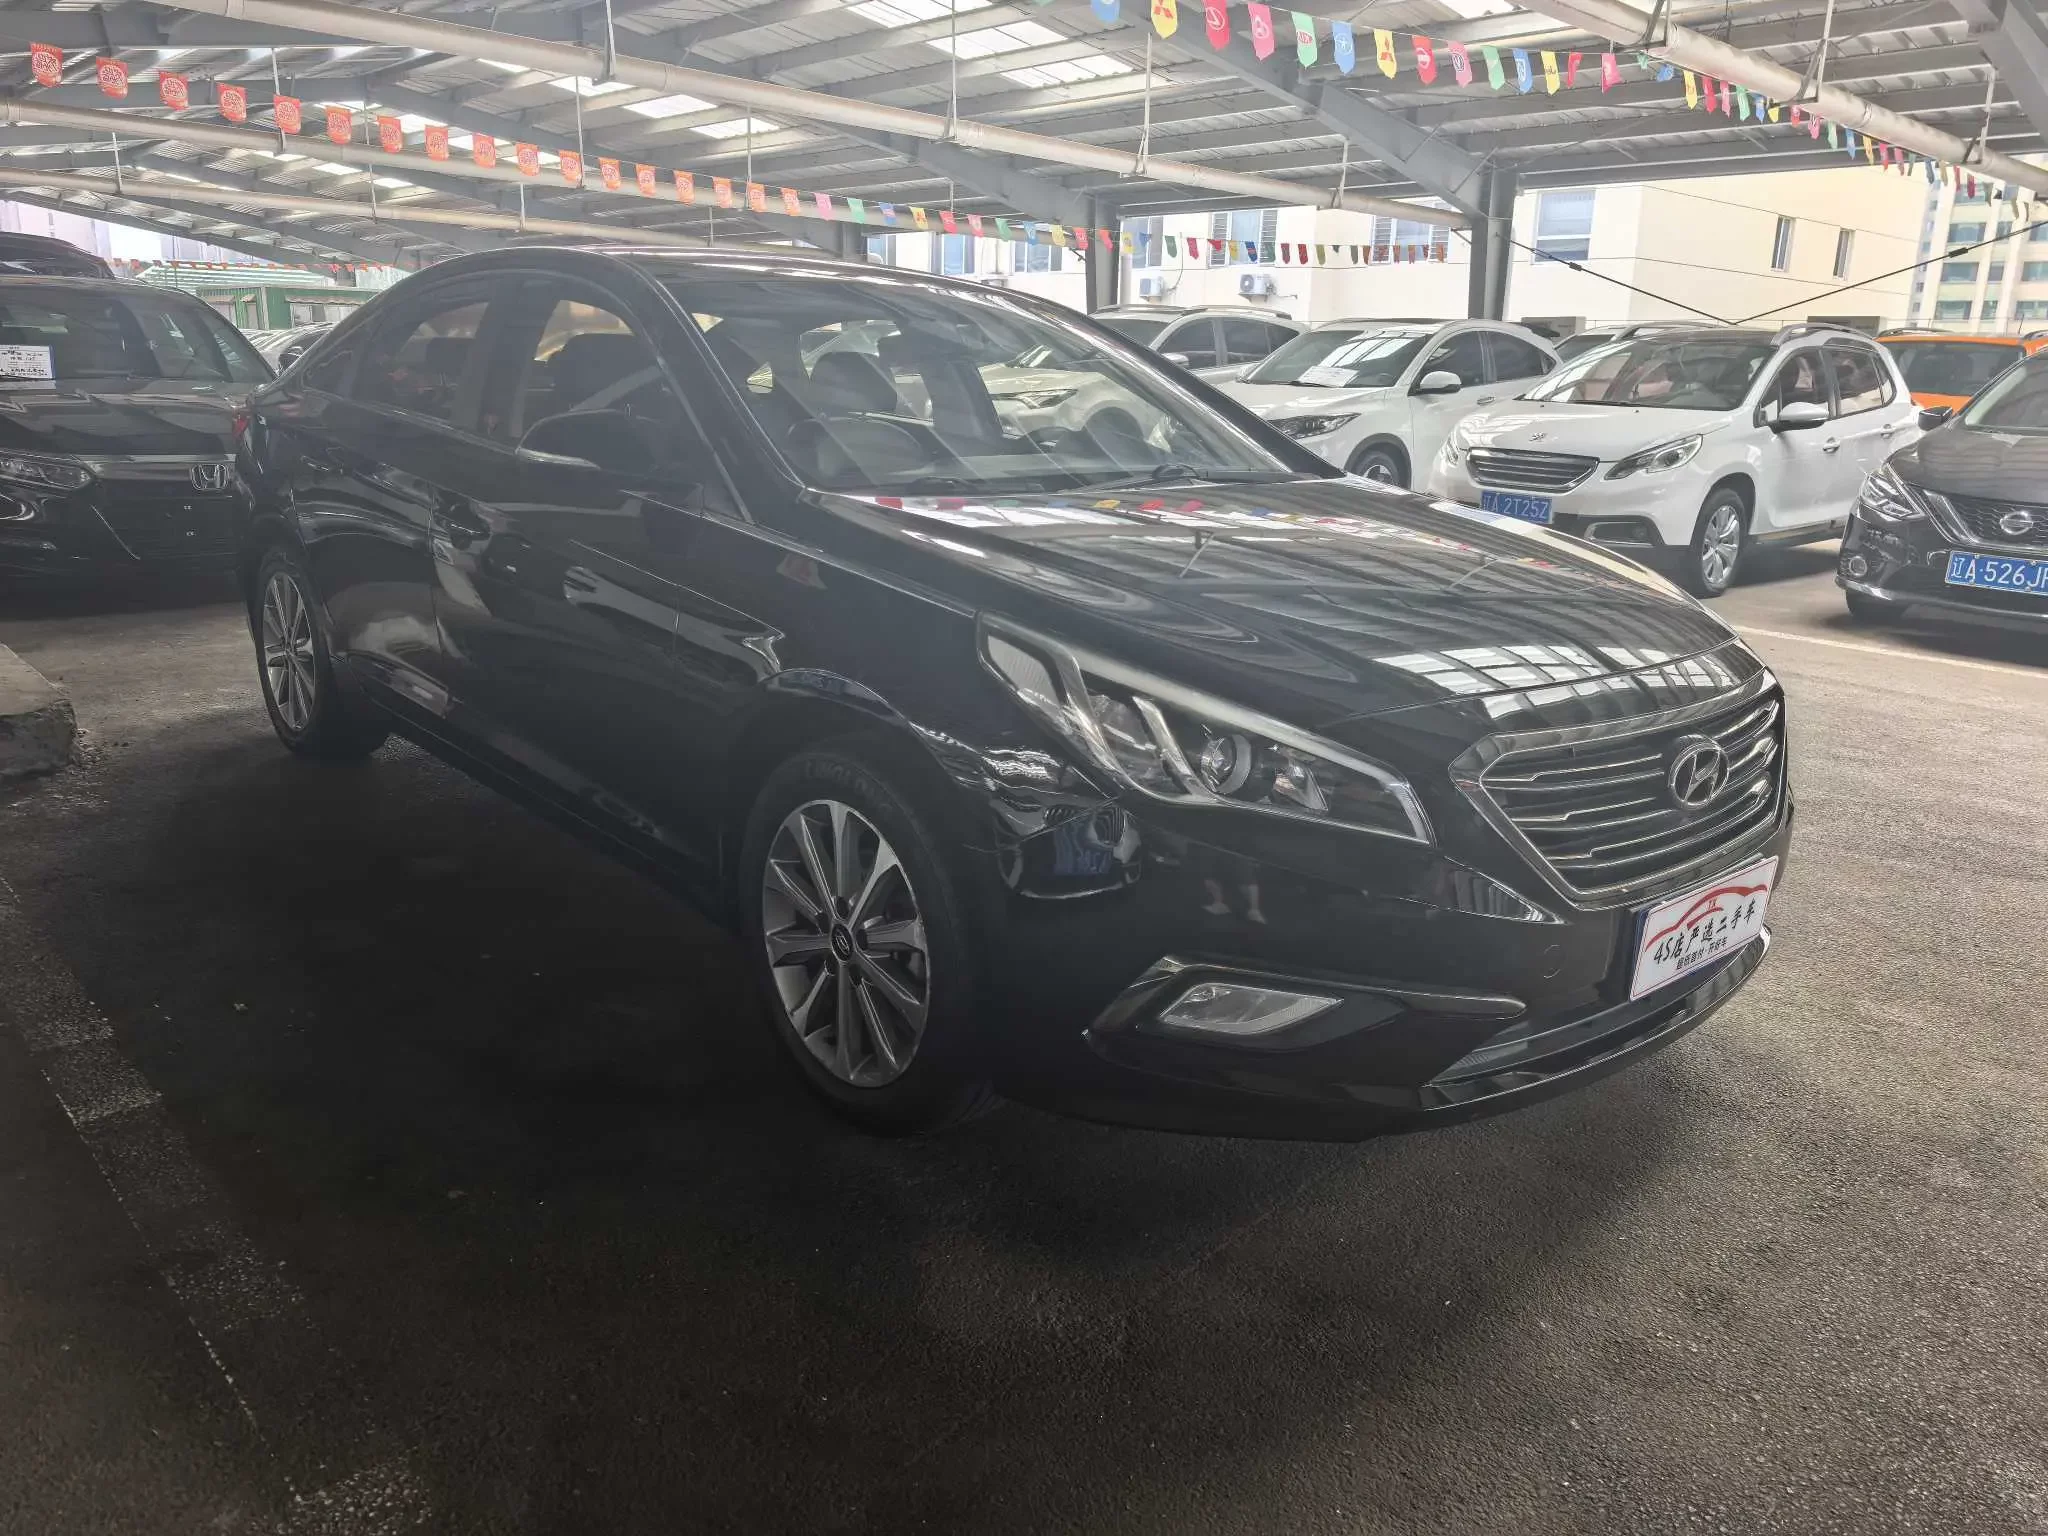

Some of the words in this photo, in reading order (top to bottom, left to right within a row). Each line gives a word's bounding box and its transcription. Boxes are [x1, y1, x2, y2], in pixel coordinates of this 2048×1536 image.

[1653, 897, 1756, 965] 4S店严选二手车
